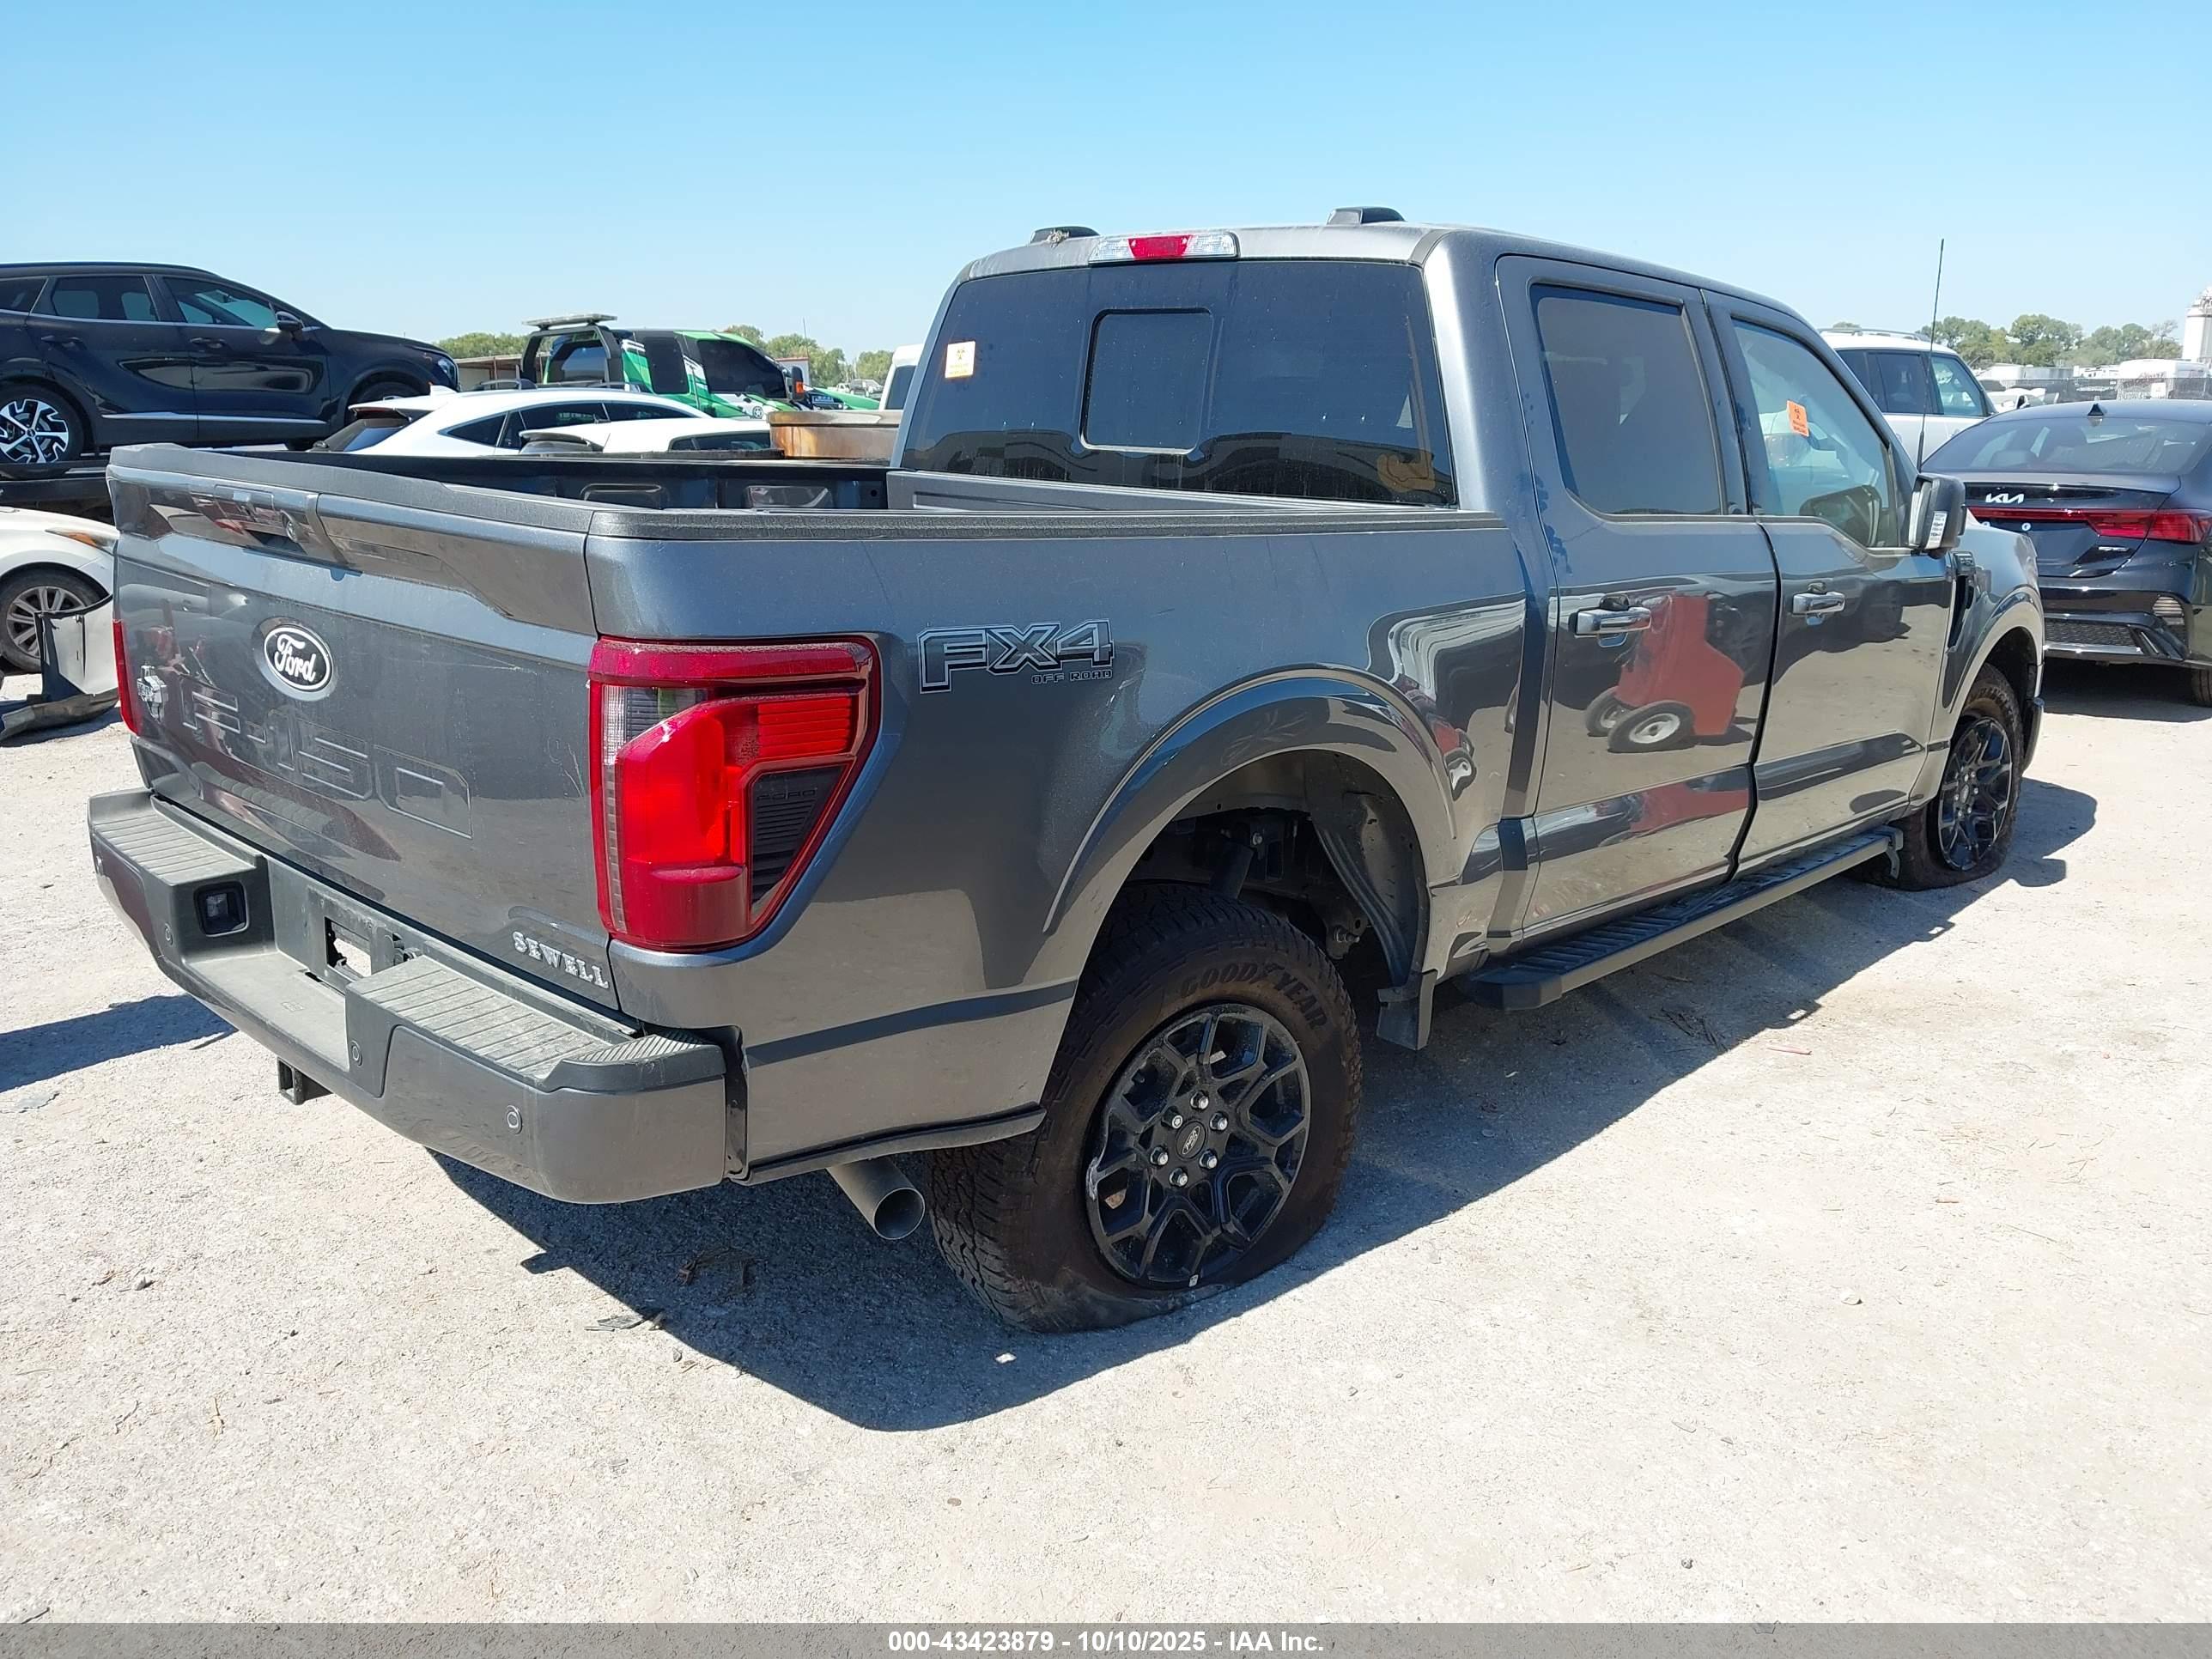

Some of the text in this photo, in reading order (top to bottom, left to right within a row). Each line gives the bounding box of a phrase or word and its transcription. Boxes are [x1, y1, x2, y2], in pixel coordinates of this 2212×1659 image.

[1985, 493, 2025, 504] KIA
[274, 633, 317, 683] Ford
[917, 618, 1115, 694] FX4
[1031, 669, 1113, 684] OFF ROAD
[513, 931, 610, 989] SEWELL
[1180, 961, 1328, 1030] GOODYEAR
